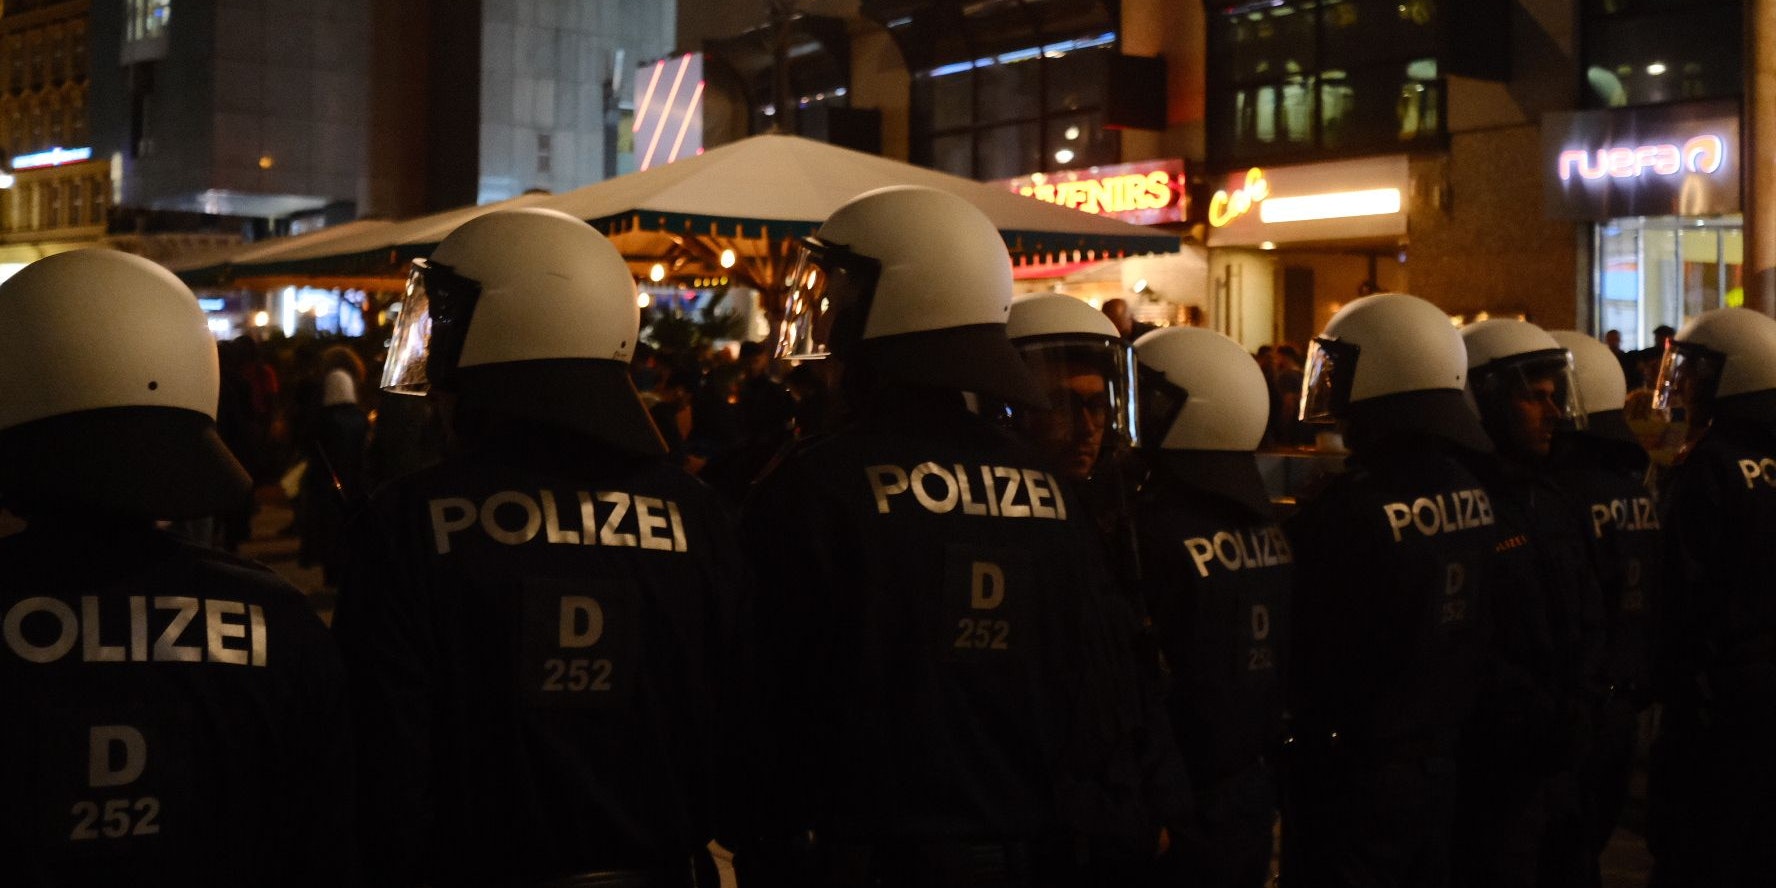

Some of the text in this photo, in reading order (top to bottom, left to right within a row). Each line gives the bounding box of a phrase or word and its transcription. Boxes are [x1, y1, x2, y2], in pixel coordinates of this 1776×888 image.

[864, 461, 1068, 521] POLIZEI
[428, 489, 688, 555] POLIZEI
[970, 561, 1007, 610] D
[3, 595, 269, 668] OLIZEI
[559, 595, 605, 649] D
[953, 617, 1010, 651] 252
[1252, 603, 1271, 641] D
[542, 658, 614, 692] 252
[88, 724, 149, 788] D
[69, 797, 161, 841] 252
